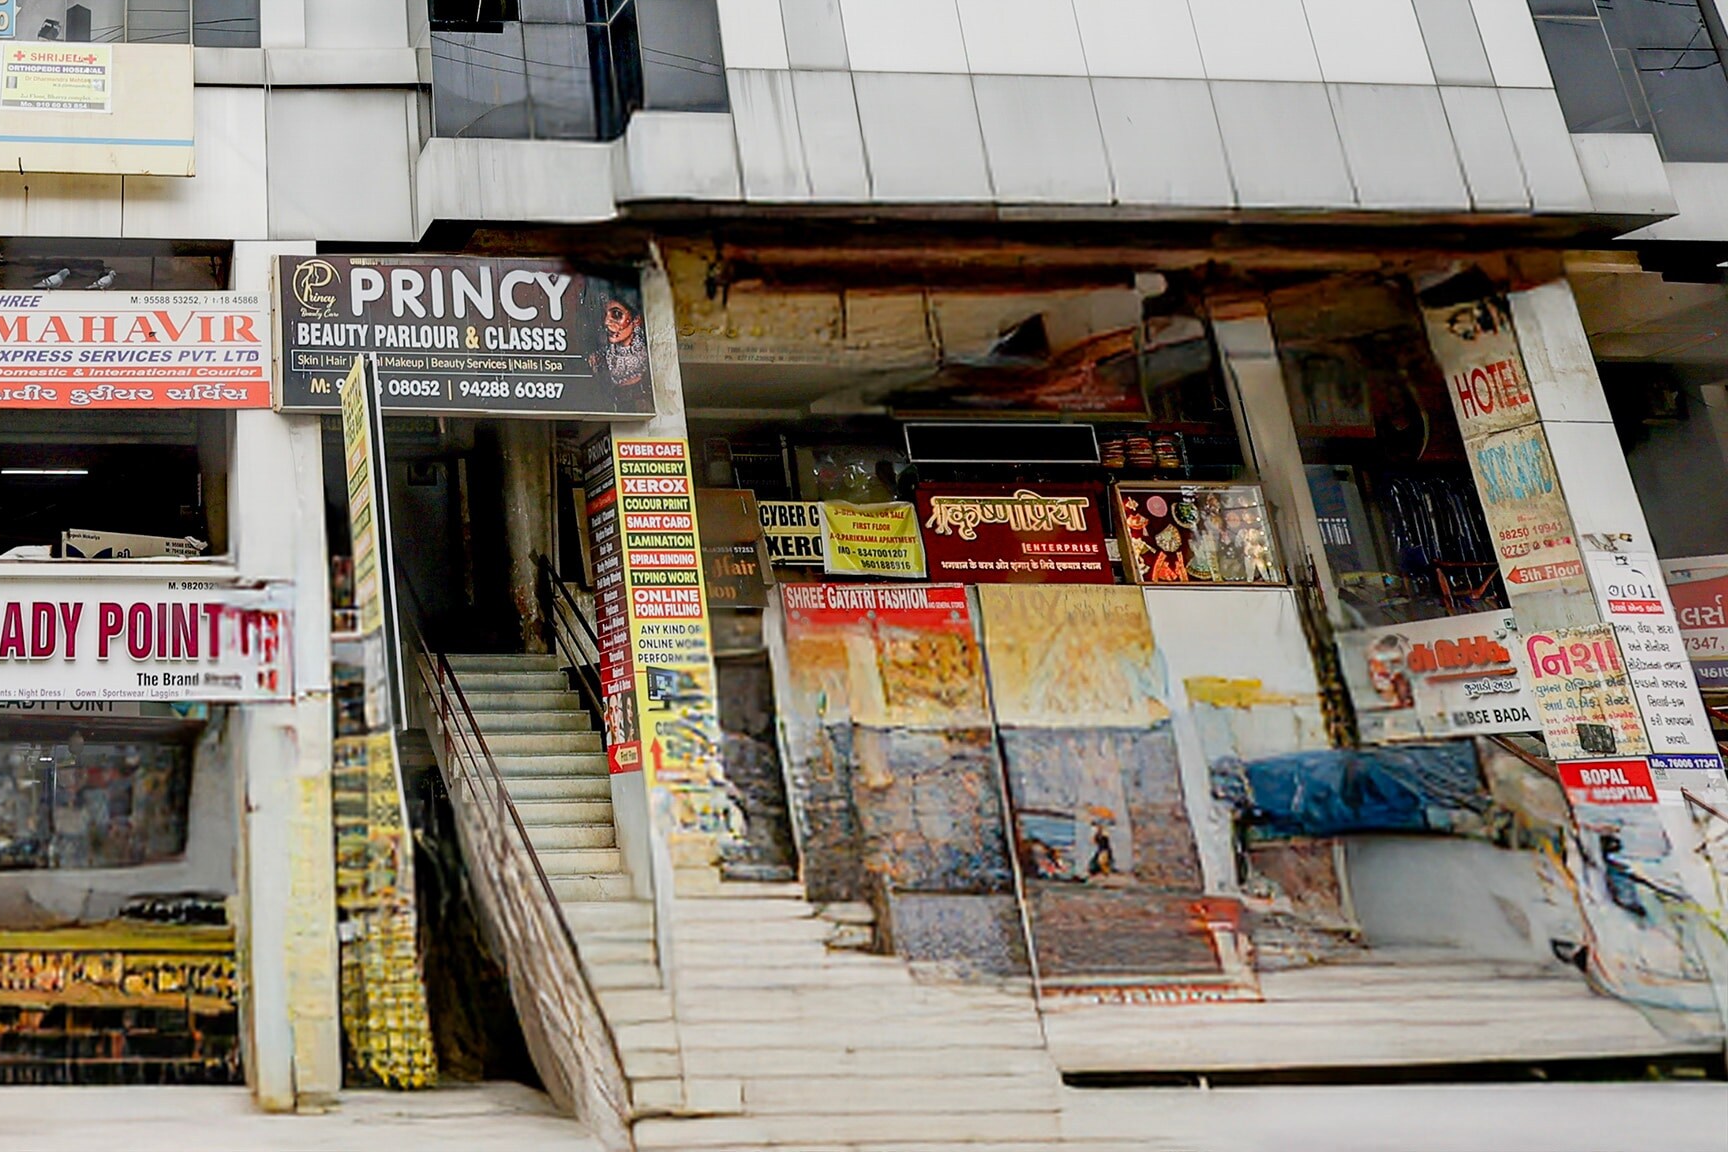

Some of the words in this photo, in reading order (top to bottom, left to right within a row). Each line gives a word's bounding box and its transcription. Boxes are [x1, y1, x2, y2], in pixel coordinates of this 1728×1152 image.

[144, 296, 170, 304] 95588
[350, 266, 572, 321] PRINCY
[297, 322, 368, 347] BEAUTY
[374, 324, 459, 349] PARLOUR
[465, 326, 480, 349] &
[485, 326, 567, 351] CLASSES
[78, 350, 172, 362] SERVICES
[178, 350, 216, 362] PVT.
[297, 354, 318, 365] Skin
[326, 355, 347, 366] Hair
[544, 360, 563, 372] Spa
[89, 368, 192, 376] International
[196, 368, 256, 376] Courier
[388, 379, 441, 396] 08052
[459, 380, 510, 398] 94288
[514, 382, 564, 399] 60387
[1454, 358, 1531, 419] HOTEL
[620, 444, 654, 456] CYBER
[655, 444, 683, 456] CAFE
[621, 462, 683, 474] STATIONERY
[624, 479, 686, 493] XEROX
[627, 516, 662, 528] SMART
[663, 516, 691, 528] CARD
[852, 522, 870, 531] FIRST
[628, 535, 693, 547] LAMINATION
[1025, 543, 1099, 553] ENTERPRISE
[630, 553, 659, 565] SPIRAL
[660, 553, 694, 565] BINDING
[632, 572, 667, 583] TYPING
[668, 572, 697, 583] WORK
[1520, 566, 1542, 583] 5th
[1544, 561, 1581, 581] Floor
[634, 589, 699, 602] ONLINE
[787, 587, 825, 609] SHREE
[827, 588, 876, 609] GAYATRI
[877, 589, 929, 609] FASHION
[636, 603, 665, 617] FORM
[96, 600, 227, 661] POINT
[137, 673, 158, 686] The
[163, 673, 199, 686] Brand
[18, 689, 38, 698] Night
[40, 689, 60, 697] Dress
[75, 689, 96, 697] Gown
[102, 689, 144, 698] Sportswear
[1494, 707, 1531, 723] BADA
[1694, 758, 1719, 769] 17347
[1580, 769, 1629, 785] BOPAL
